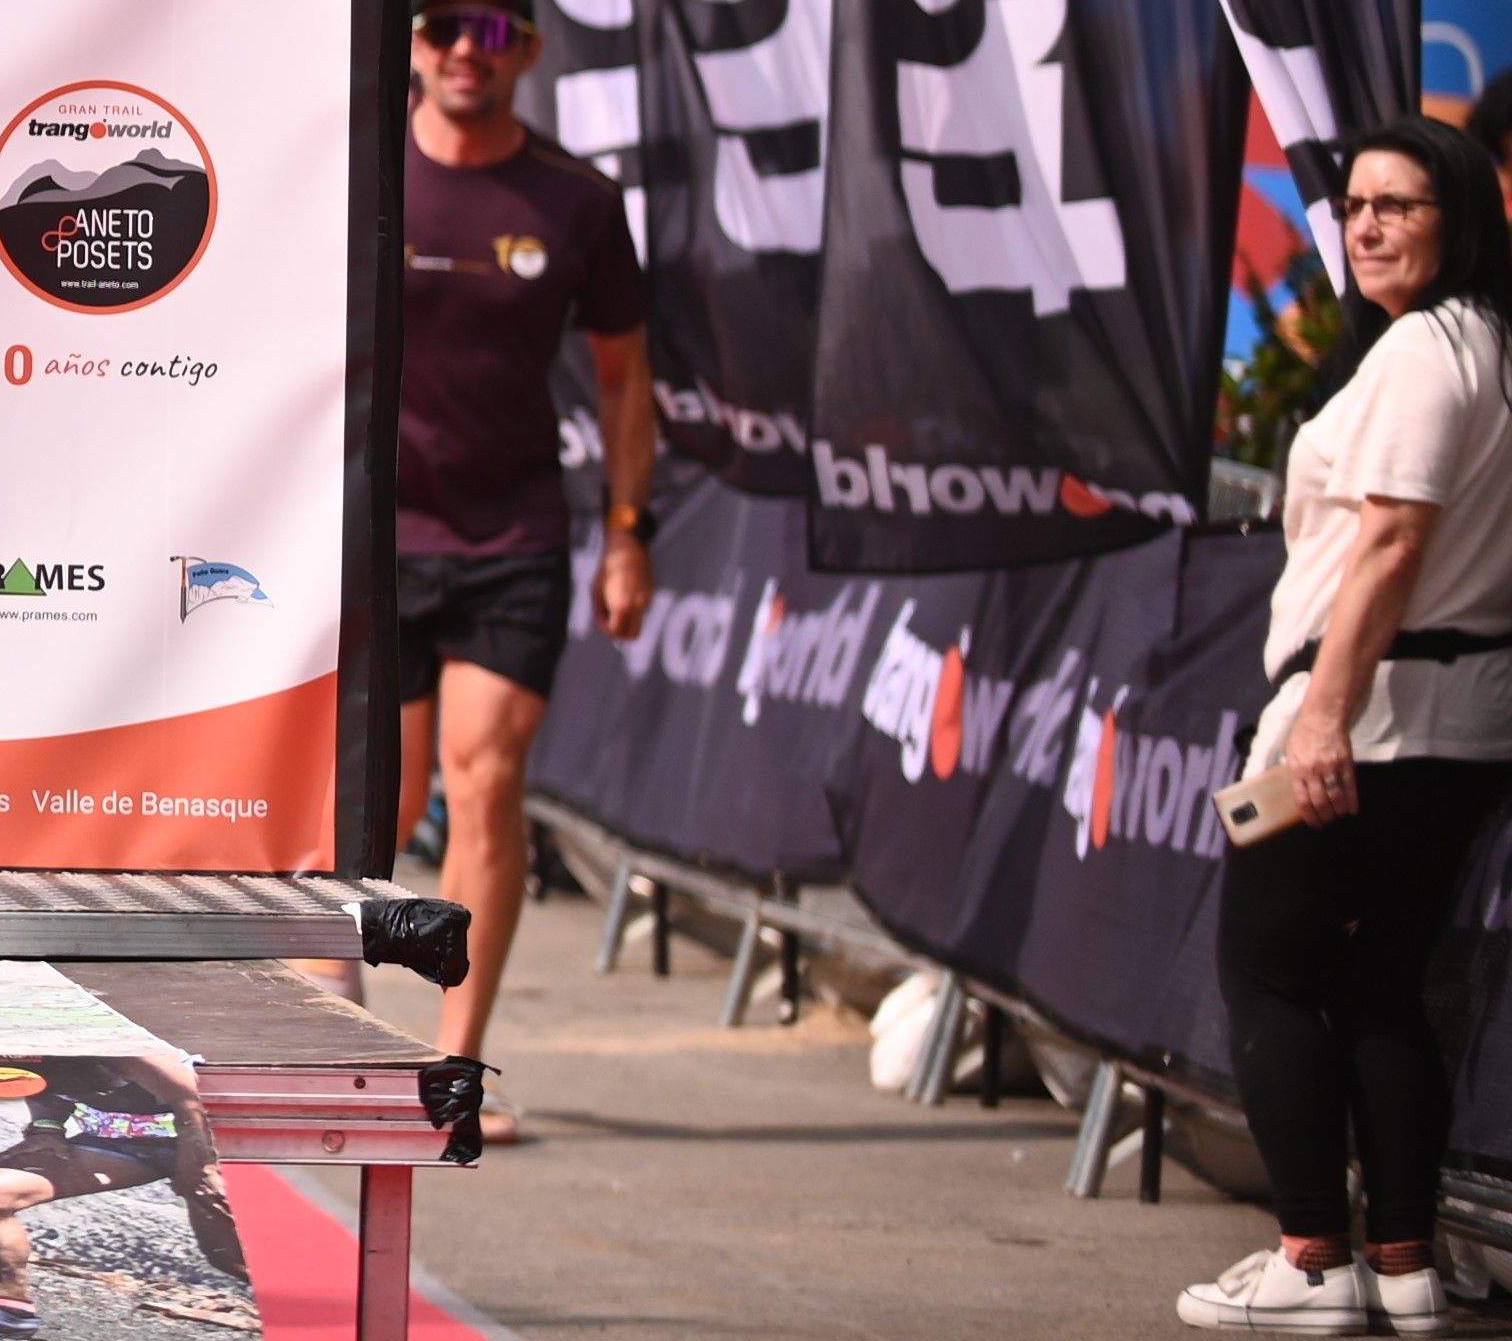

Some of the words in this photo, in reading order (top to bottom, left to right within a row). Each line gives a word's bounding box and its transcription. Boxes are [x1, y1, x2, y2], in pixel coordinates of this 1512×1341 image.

[58, 105, 97, 115] GRAN
[104, 105, 143, 115] TRAIL
[28, 118, 172, 141] trangoworld
[76, 209, 154, 238] ANETO
[57, 240, 153, 270] POSETS
[44, 354, 110, 377] años
[120, 354, 218, 386] contigo
[32, 789, 94, 814] Valle
[102, 790, 133, 815] de
[142, 790, 268, 821] Benasque
